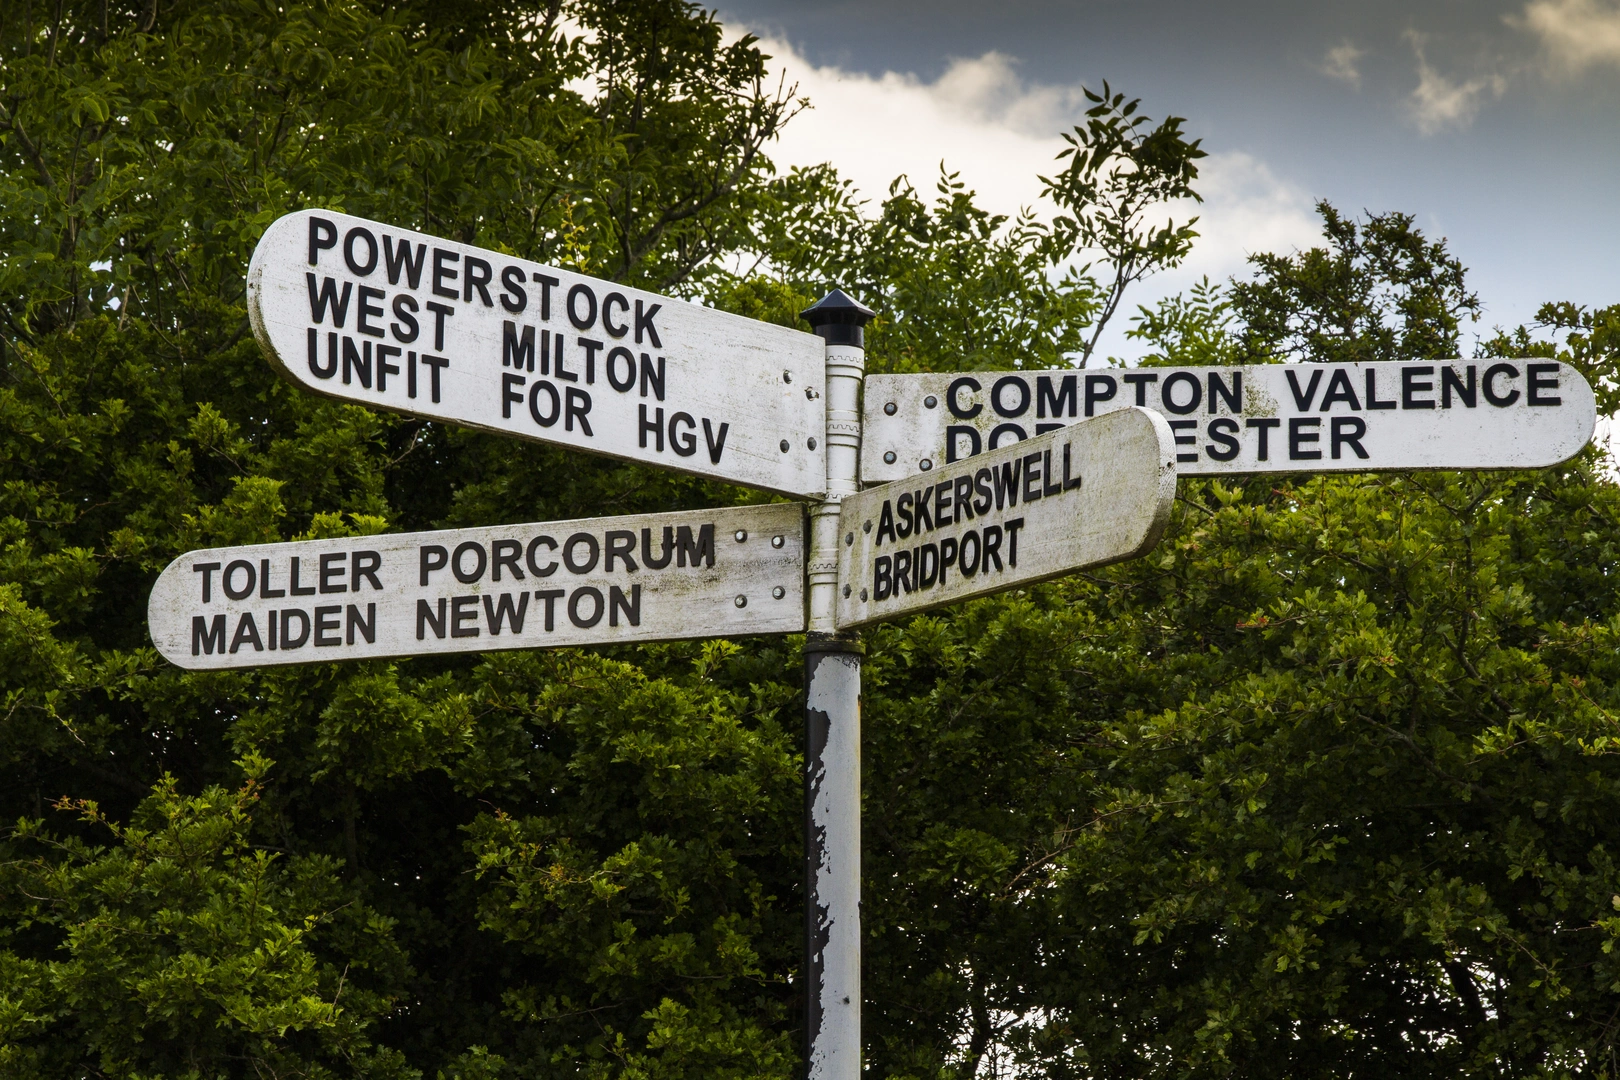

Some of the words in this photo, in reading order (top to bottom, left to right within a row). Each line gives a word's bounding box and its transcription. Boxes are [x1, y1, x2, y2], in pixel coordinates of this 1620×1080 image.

[308, 217, 662, 349] POWERSTOCK
[306, 272, 454, 352] WEST
[502, 320, 666, 401] MILTON
[307, 328, 450, 404] UNFIT
[502, 372, 594, 437] FOR
[638, 403, 730, 465] HGV
[946, 371, 1243, 420] COMPTON
[1284, 363, 1562, 412] VALENCE
[946, 416, 1370, 464] DOESTER
[876, 443, 1082, 546] ASKERSWELL
[193, 550, 384, 601] TOLLER
[419, 524, 716, 587] PORCORUM
[873, 519, 1025, 601] BRIDPORT
[191, 603, 377, 656] MAIDEN
[416, 584, 642, 640] NEWTON
